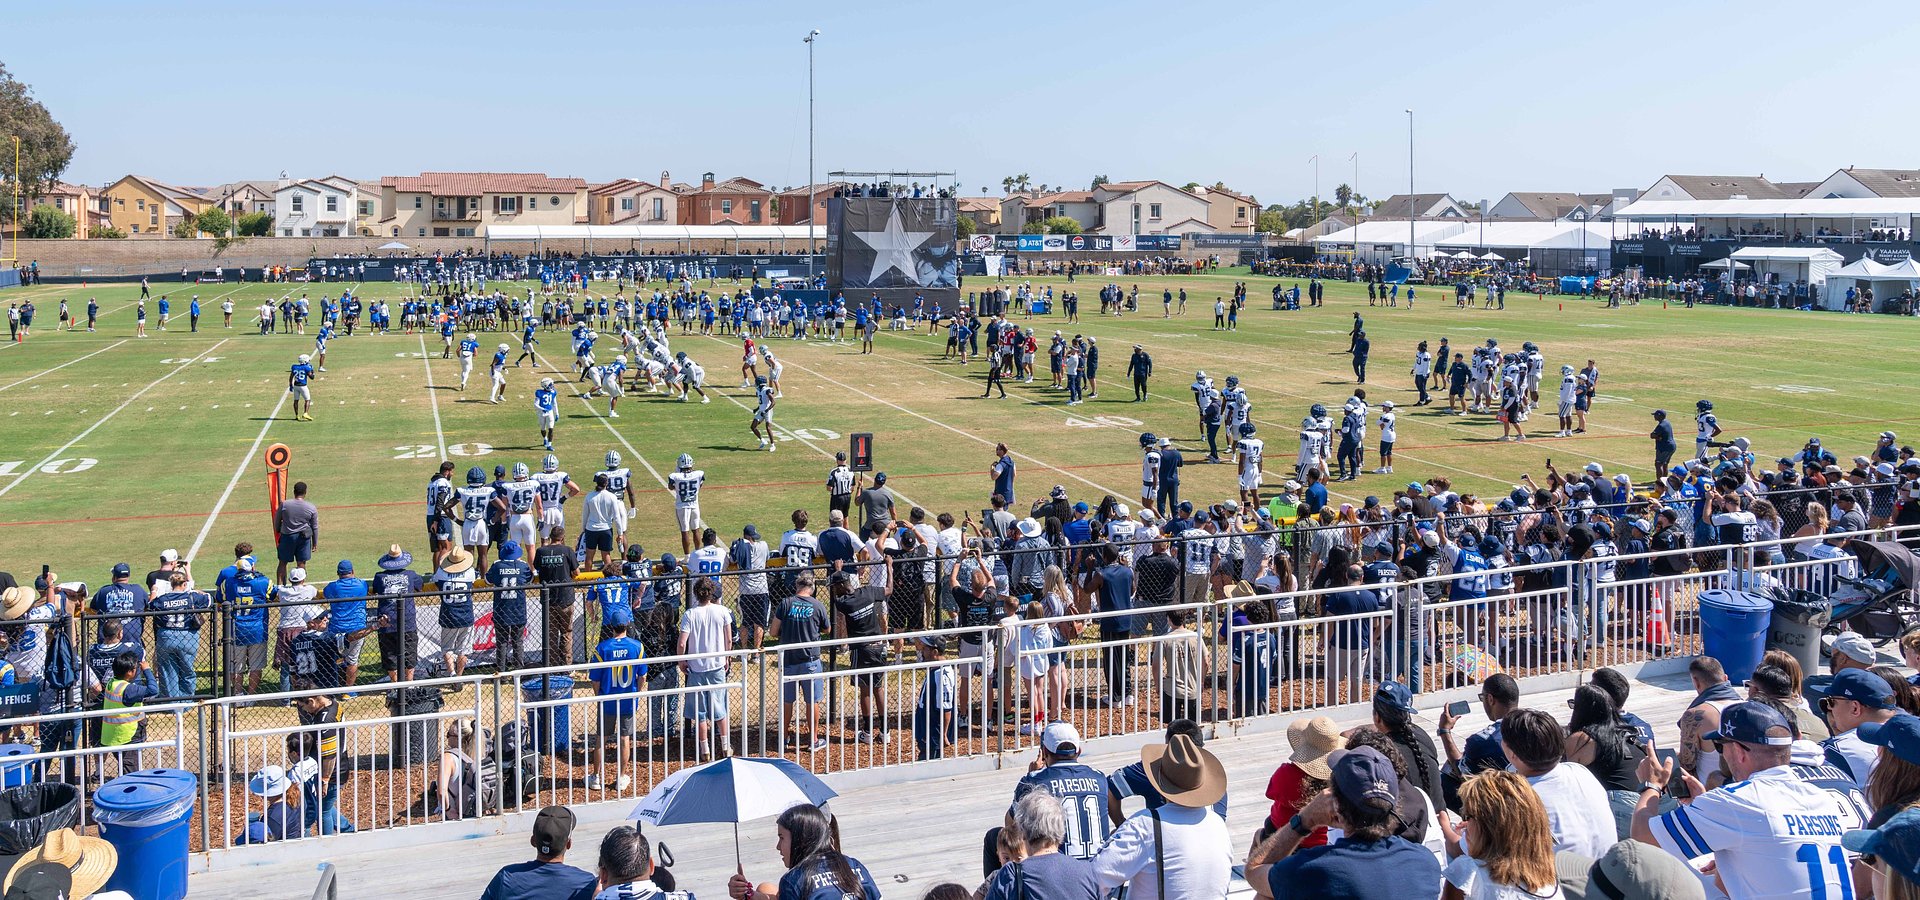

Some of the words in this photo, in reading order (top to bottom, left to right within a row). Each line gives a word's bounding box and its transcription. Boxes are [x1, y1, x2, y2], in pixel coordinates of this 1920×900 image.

[1094, 238, 1111, 250] Lite
[293, 369, 306, 382] 26
[542, 394, 552, 405] 31
[393, 442, 494, 460] 20
[857, 437, 866, 458] 1
[511, 490, 533, 504] 46
[540, 481, 559, 501] 87
[678, 480, 699, 497] 85
[464, 496, 486, 513] 45
[1741, 524, 1760, 542] 88
[1377, 569, 1398, 577] PARSONS
[500, 577, 518, 600] 11
[163, 598, 189, 608] PARSONS
[235, 596, 254, 616] 17
[612, 649, 628, 658] KUPP
[611, 664, 633, 688] 10
[5, 694, 32, 705] FENCE
[1050, 778, 1101, 794] PARSONS
[1061, 795, 1105, 859] 11
[1782, 813, 1844, 837] PARSONS
[1796, 843, 1854, 900] 11
